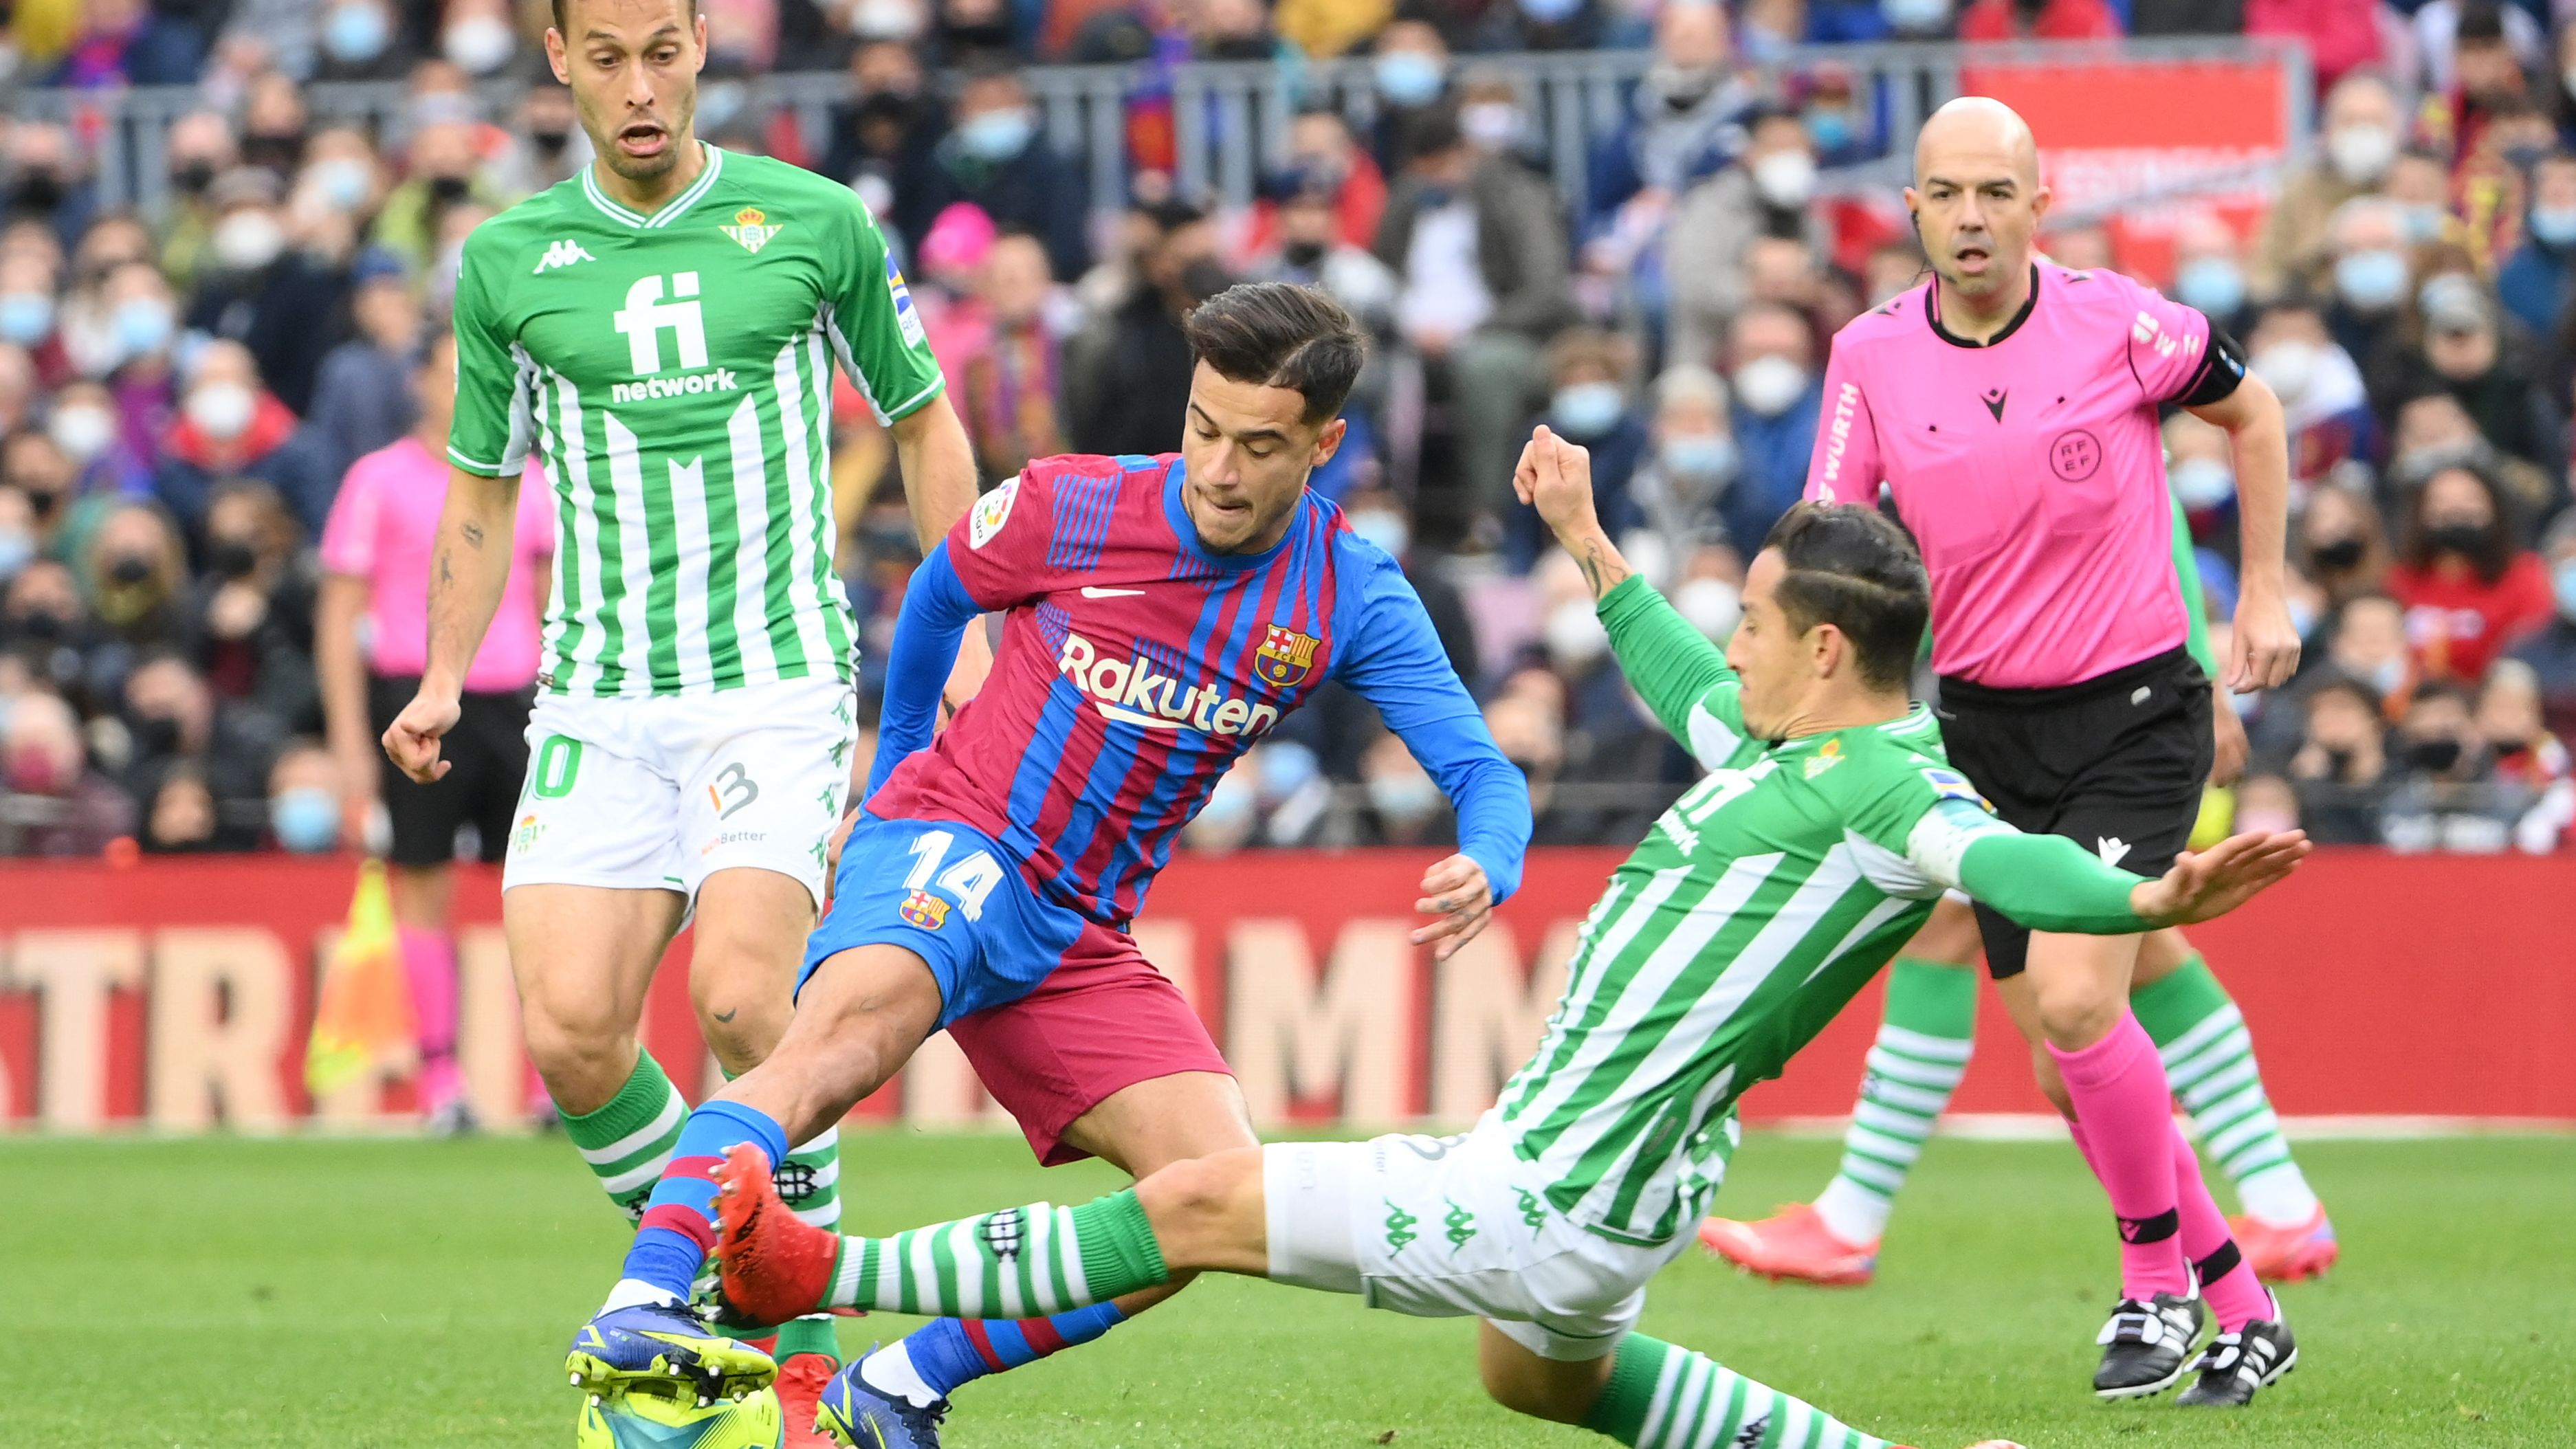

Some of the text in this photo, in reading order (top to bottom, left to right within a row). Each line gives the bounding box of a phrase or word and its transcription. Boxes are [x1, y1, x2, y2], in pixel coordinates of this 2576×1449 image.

[613, 271, 709, 375] fi
[612, 367, 738, 404] network
[1059, 632, 1279, 737] Rakuten
[1273, 651, 1296, 663] FCB
[901, 830, 1004, 922] 14
